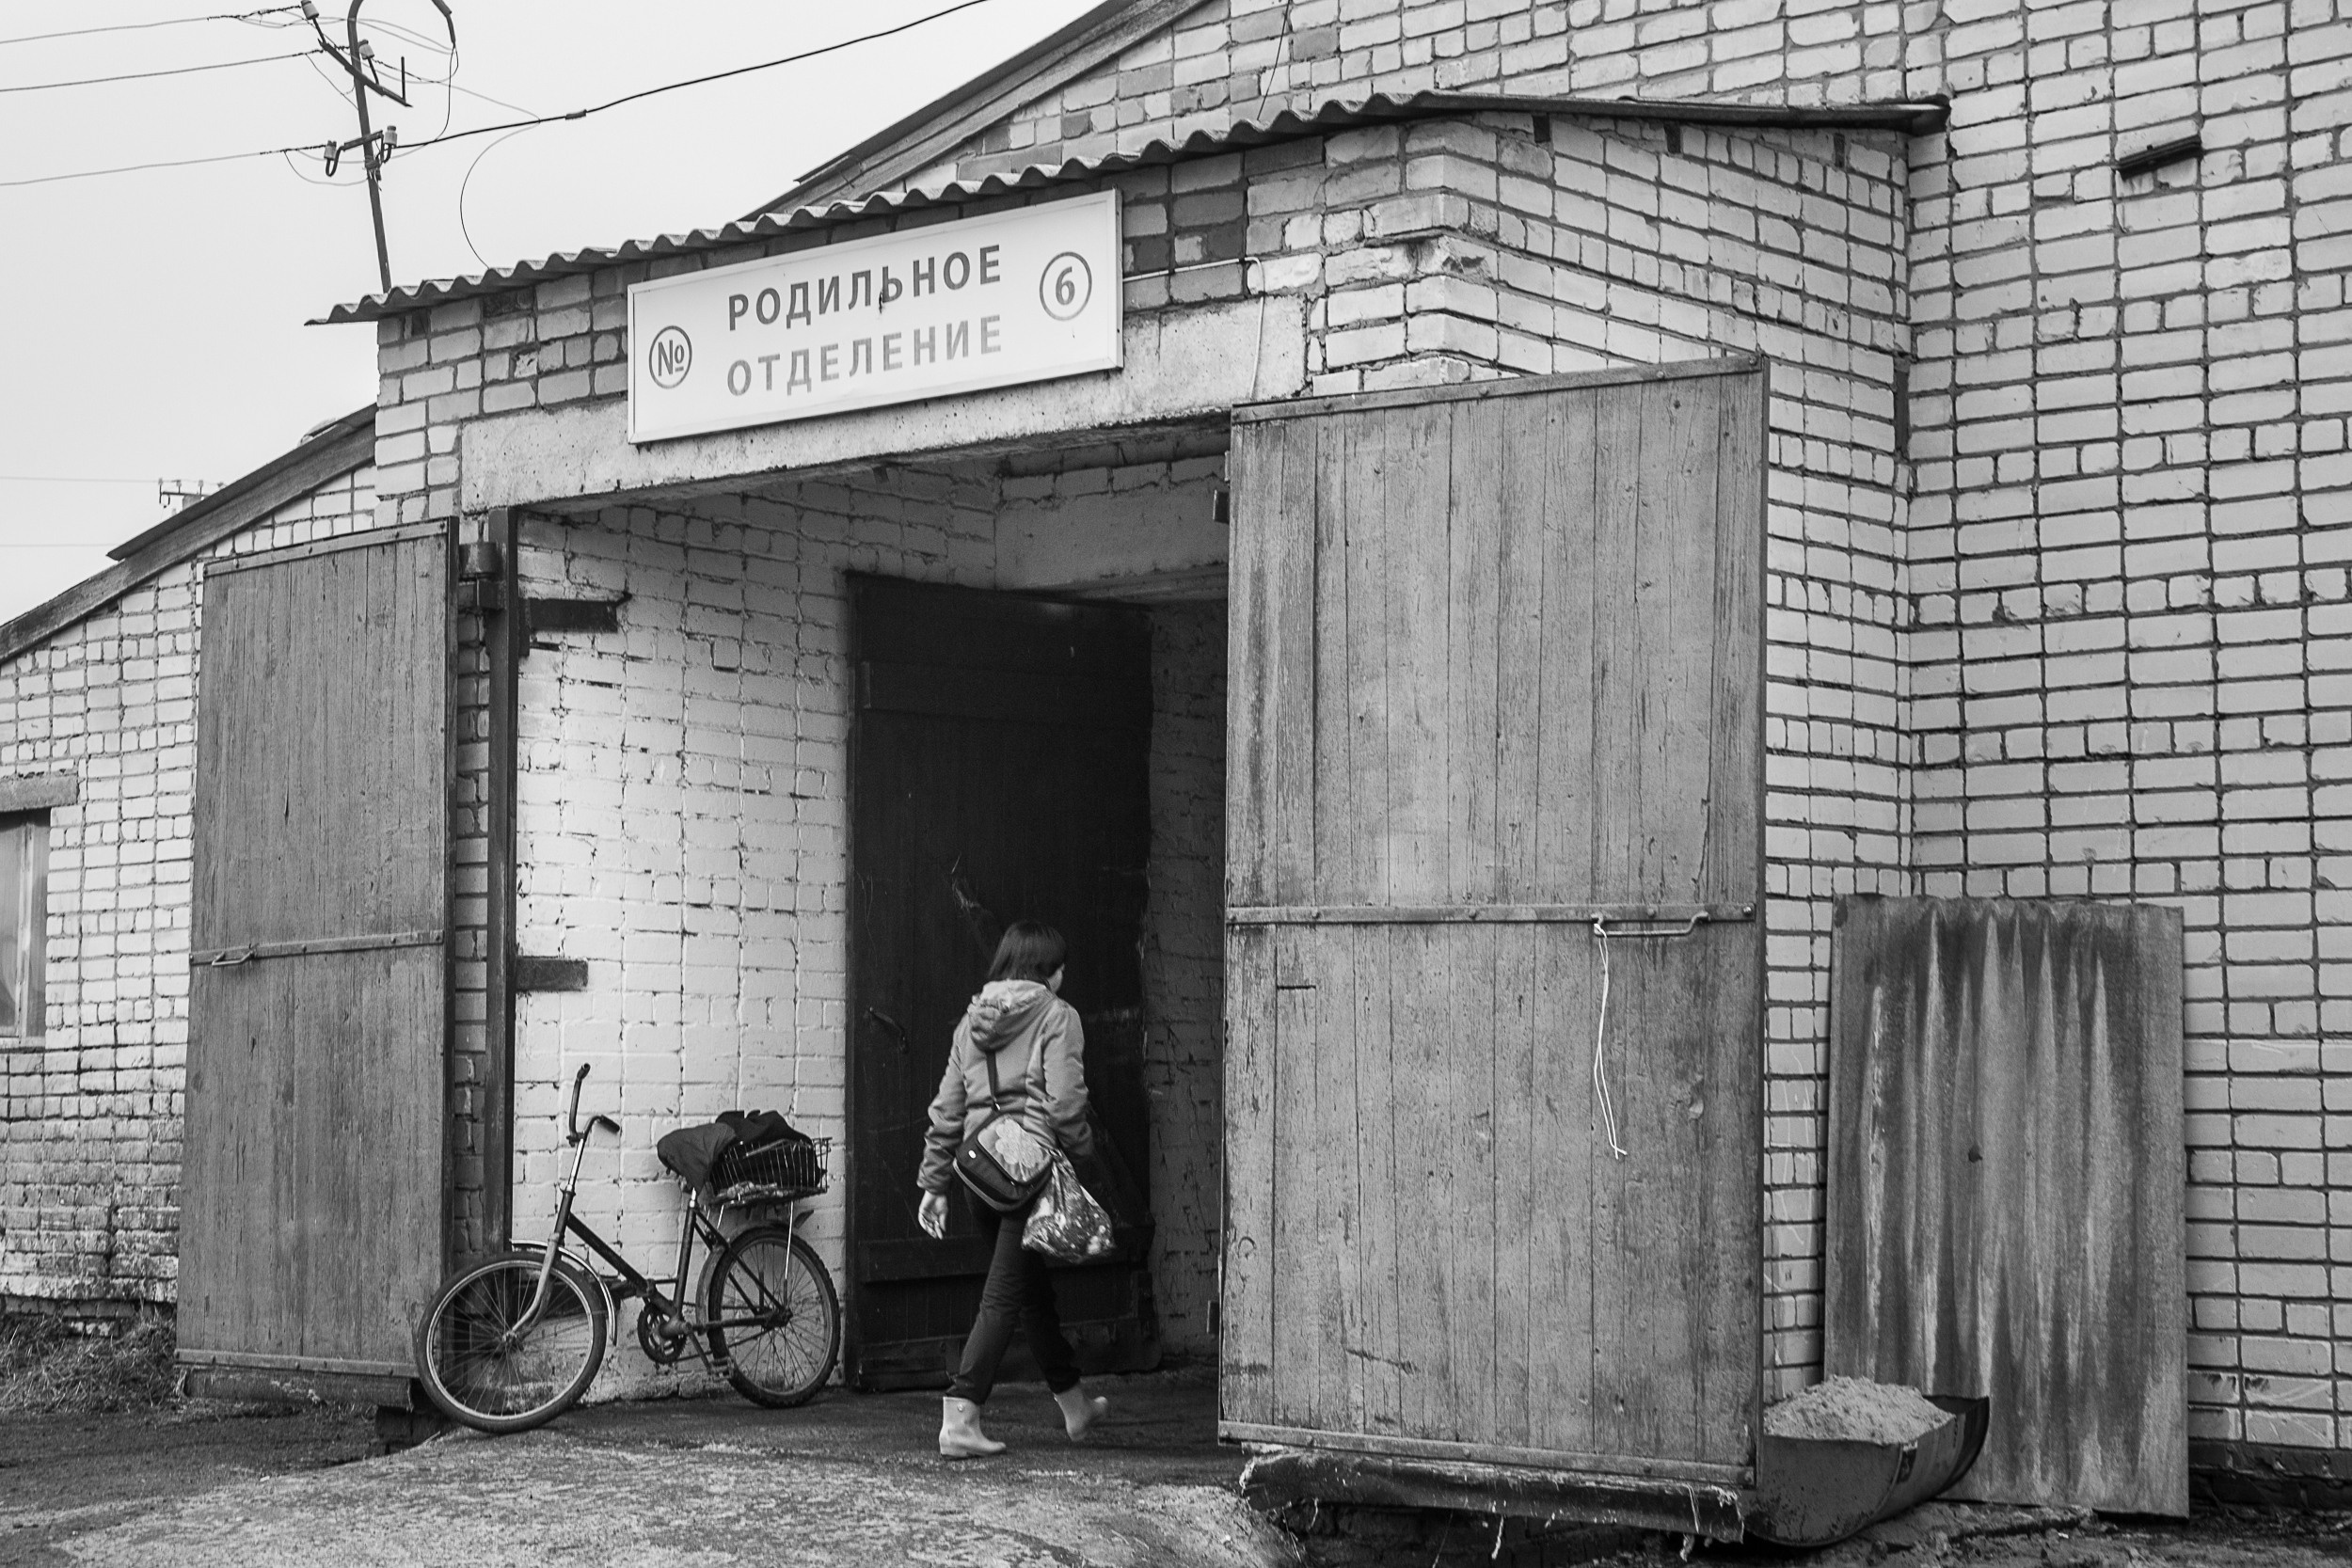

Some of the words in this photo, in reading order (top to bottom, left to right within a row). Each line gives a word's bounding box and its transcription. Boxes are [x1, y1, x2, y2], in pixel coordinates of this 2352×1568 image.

[728, 244, 1001, 331] РОДИЛЬНОЕ
[1055, 265, 1076, 306] 6
[658, 339, 686, 377] №
[727, 314, 1002, 397] ОТДЕЛЕНИЕ
